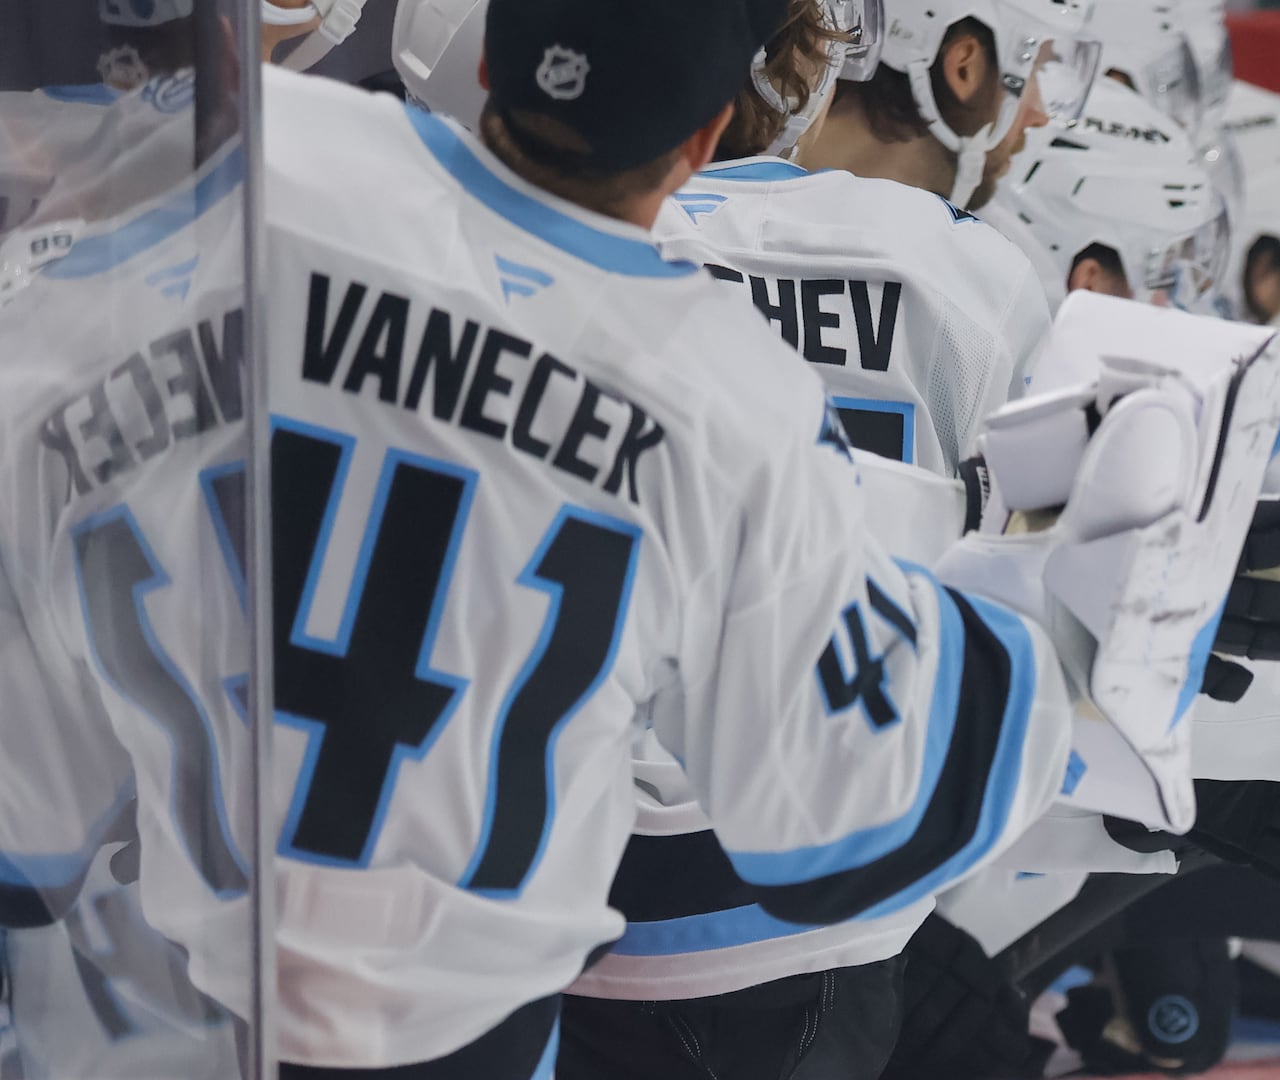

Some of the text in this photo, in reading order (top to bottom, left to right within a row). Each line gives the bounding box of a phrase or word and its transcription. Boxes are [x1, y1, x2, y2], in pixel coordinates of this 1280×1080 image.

[301, 271, 665, 504] VANECEK
[703, 262, 902, 372] HEV
[270, 413, 642, 901] 41
